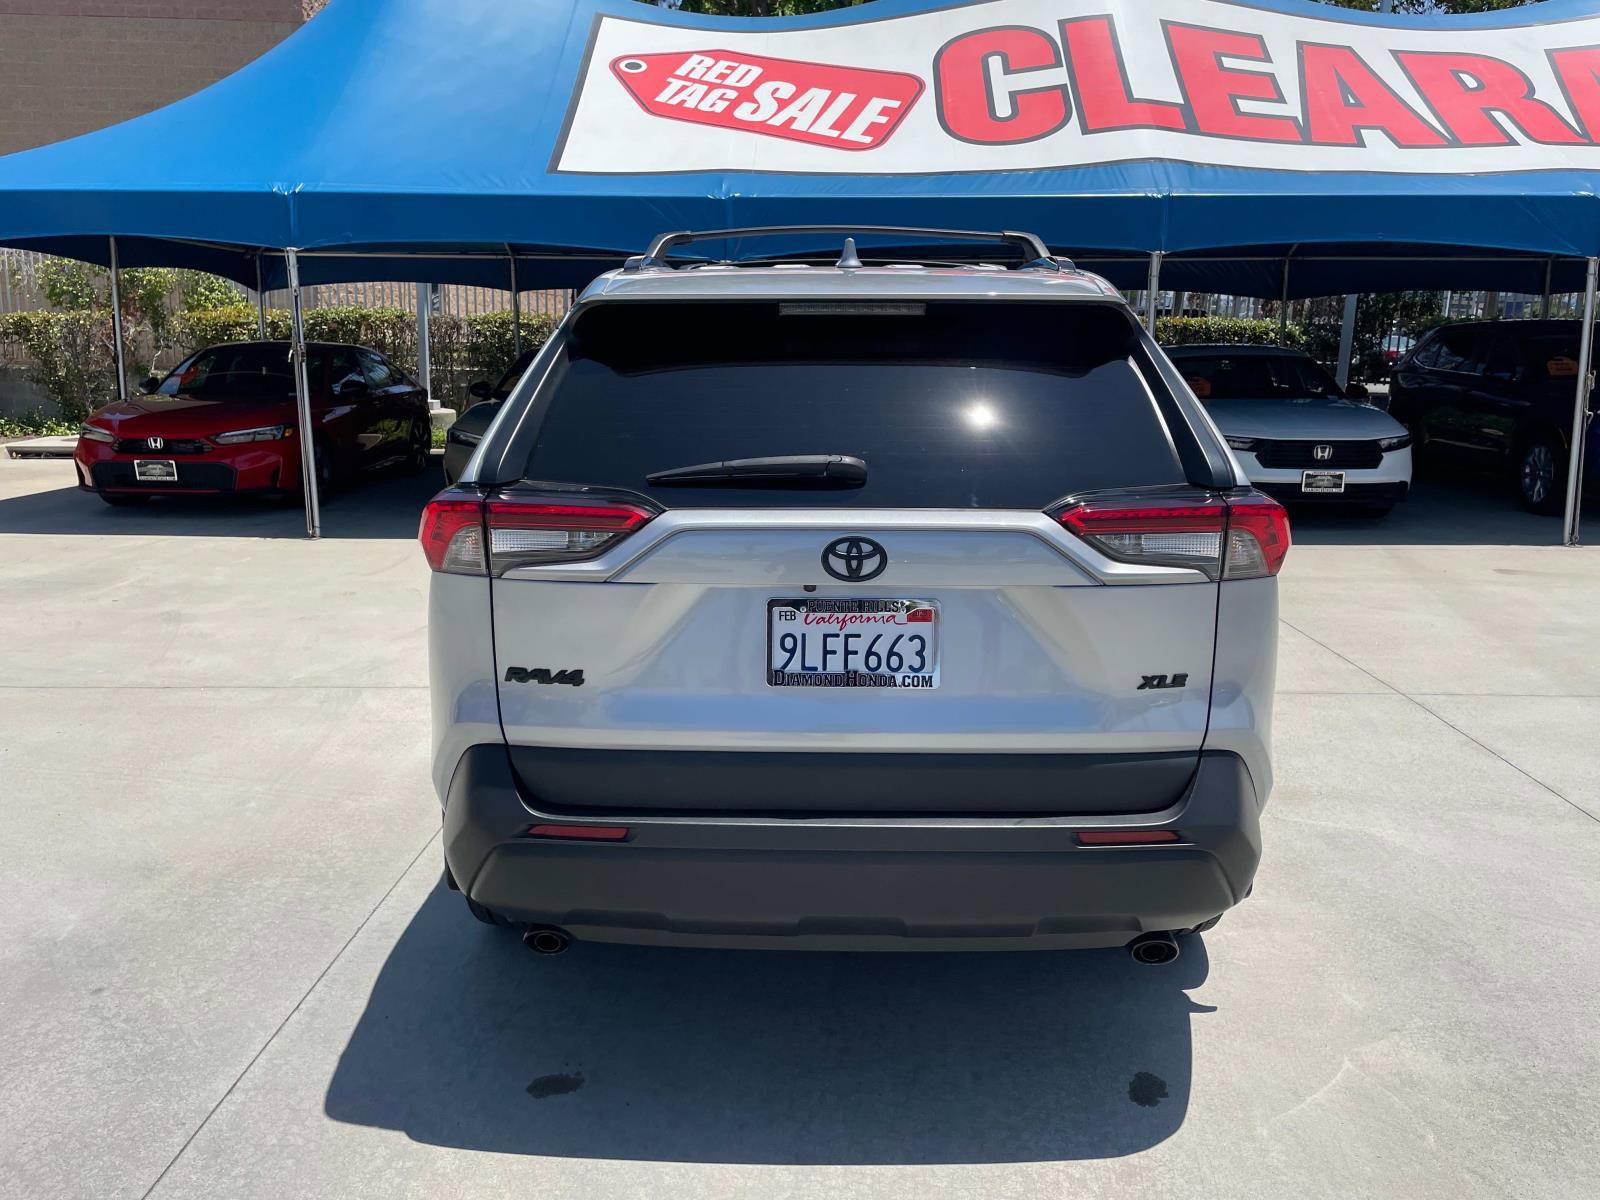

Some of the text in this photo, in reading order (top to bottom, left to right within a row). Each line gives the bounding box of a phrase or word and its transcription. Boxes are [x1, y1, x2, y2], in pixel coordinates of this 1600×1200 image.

[675, 53, 763, 88] RED
[655, 77, 902, 144] TAG SALE
[807, 600, 901, 613] PUENTE HILLS
[779, 611, 797, 621] FEB
[804, 613, 907, 631] California
[779, 632, 926, 673] 9LFF663
[504, 667, 585, 686] RAV4
[1137, 673, 1188, 690] XLE
